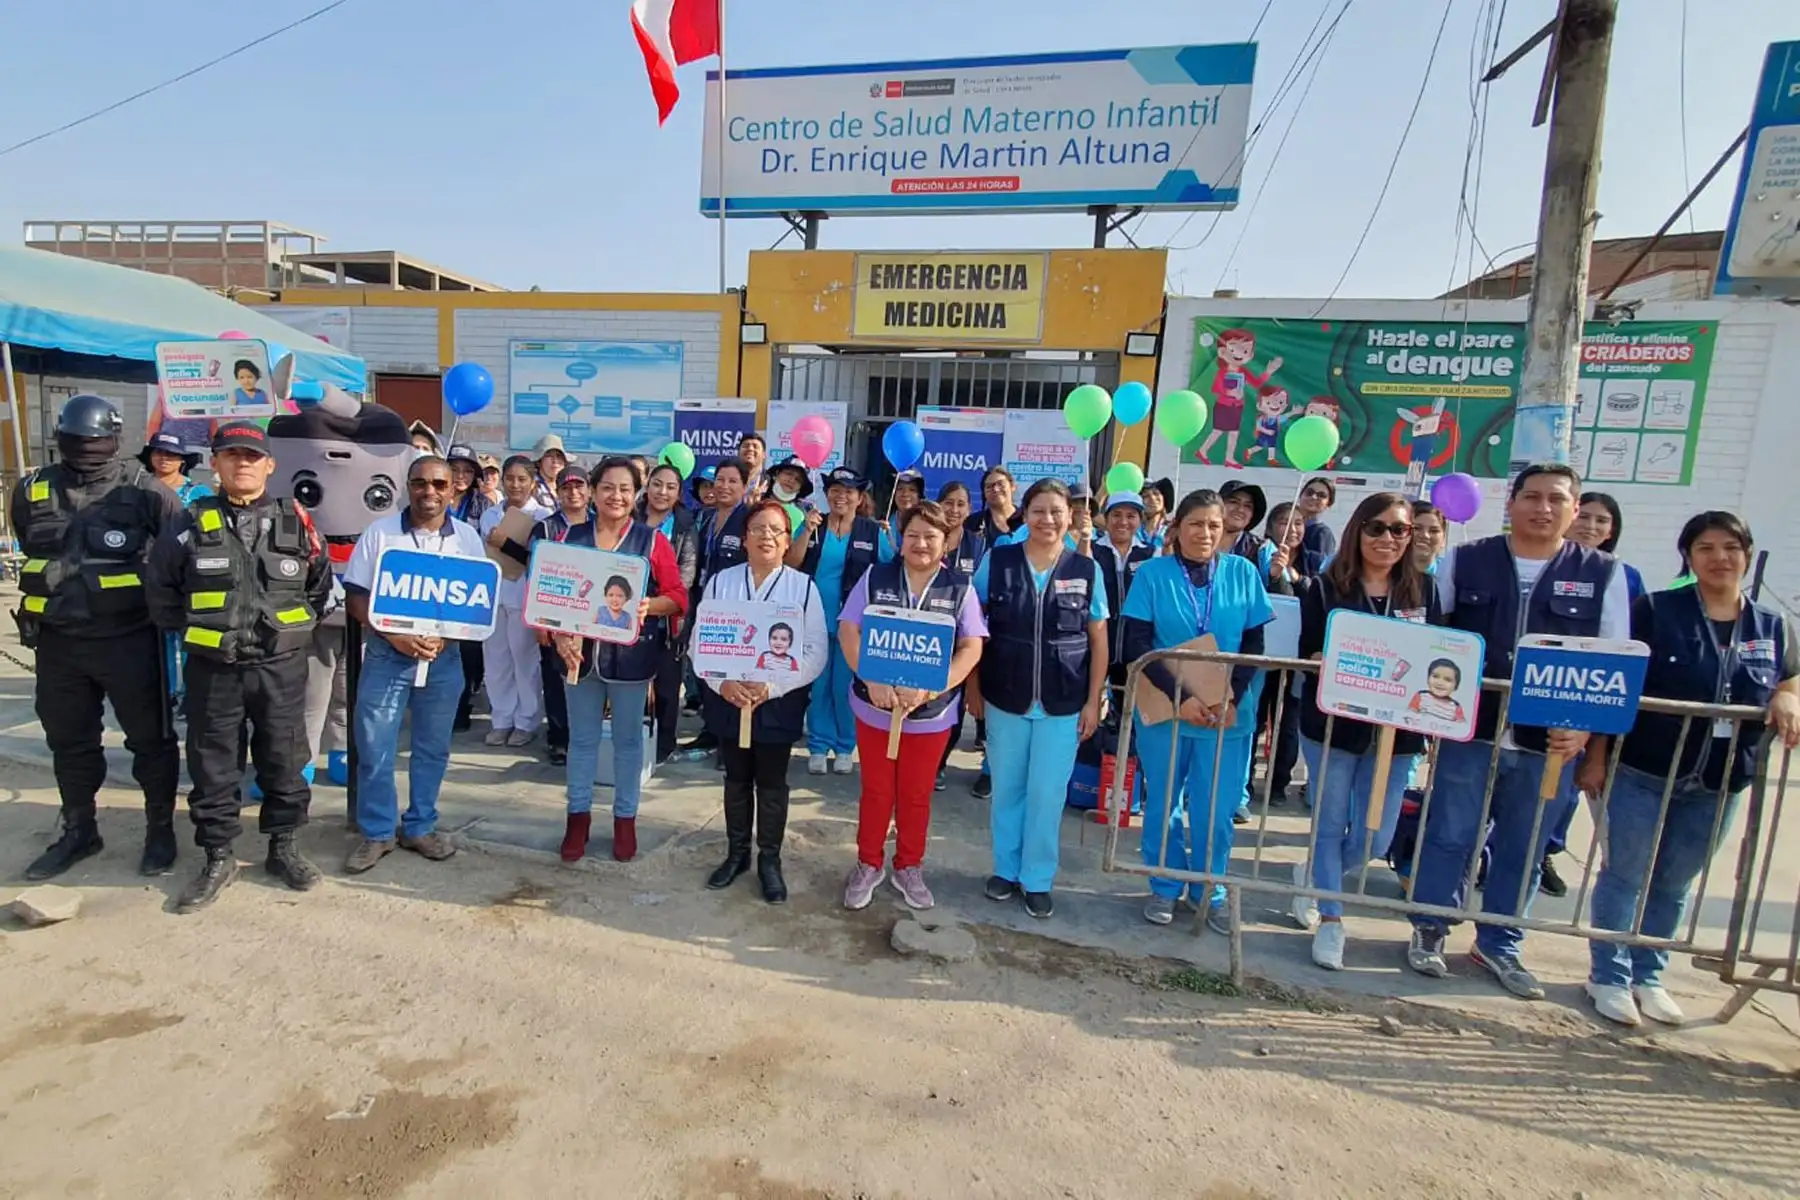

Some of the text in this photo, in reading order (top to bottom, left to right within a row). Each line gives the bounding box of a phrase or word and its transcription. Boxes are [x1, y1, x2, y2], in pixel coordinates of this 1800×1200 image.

[728, 95, 1220, 142] Centro de Salud Materno Infantil
[761, 135, 1171, 177] Dr. Enrique Martin Altuna
[896, 179, 944, 193] ATENCIÓN
[980, 178, 1015, 191] HORAS
[869, 263, 1029, 291] EMERGENCIA
[884, 301, 1007, 329] MEDICINA
[1367, 329, 1515, 352] Hazle el pare
[1583, 346, 1691, 361] CRIADEROS
[1366, 349, 1514, 382] al dengue
[923, 451, 989, 471] MINSA
[379, 571, 491, 609] MINSA
[699, 645, 756, 656] sarampión
[700, 634, 726, 644] polio
[868, 628, 943, 657] MINSA
[867, 648, 942, 667] DIRIS LIMA NORTE
[1338, 661, 1370, 675] polio
[1336, 673, 1405, 696] sarampión
[1524, 663, 1628, 696] MINSA
[1521, 686, 1627, 708] DIRIS LIMA NORTE
